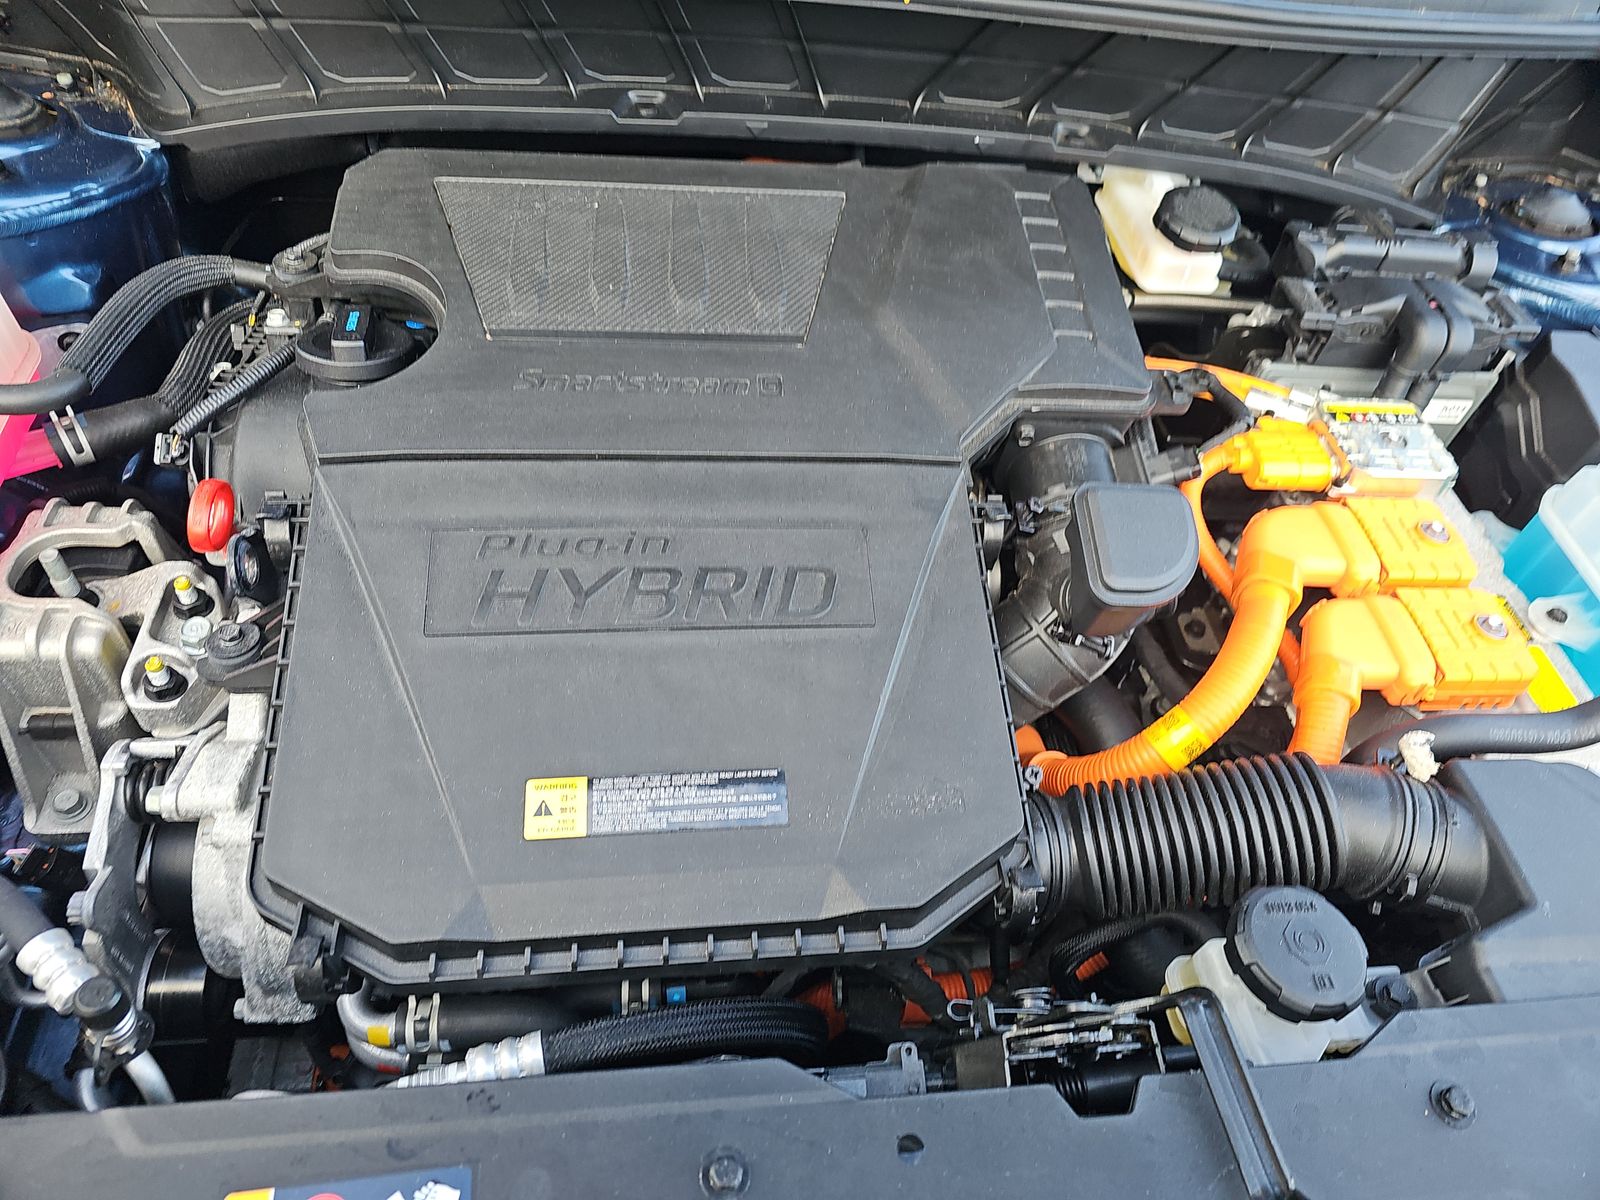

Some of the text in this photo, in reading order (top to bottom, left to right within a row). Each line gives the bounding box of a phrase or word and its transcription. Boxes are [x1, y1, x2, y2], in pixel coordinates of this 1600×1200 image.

[512, 367, 750, 396] Smartstream
[476, 531, 671, 560] Plug-in
[471, 565, 838, 627] HYBRID
